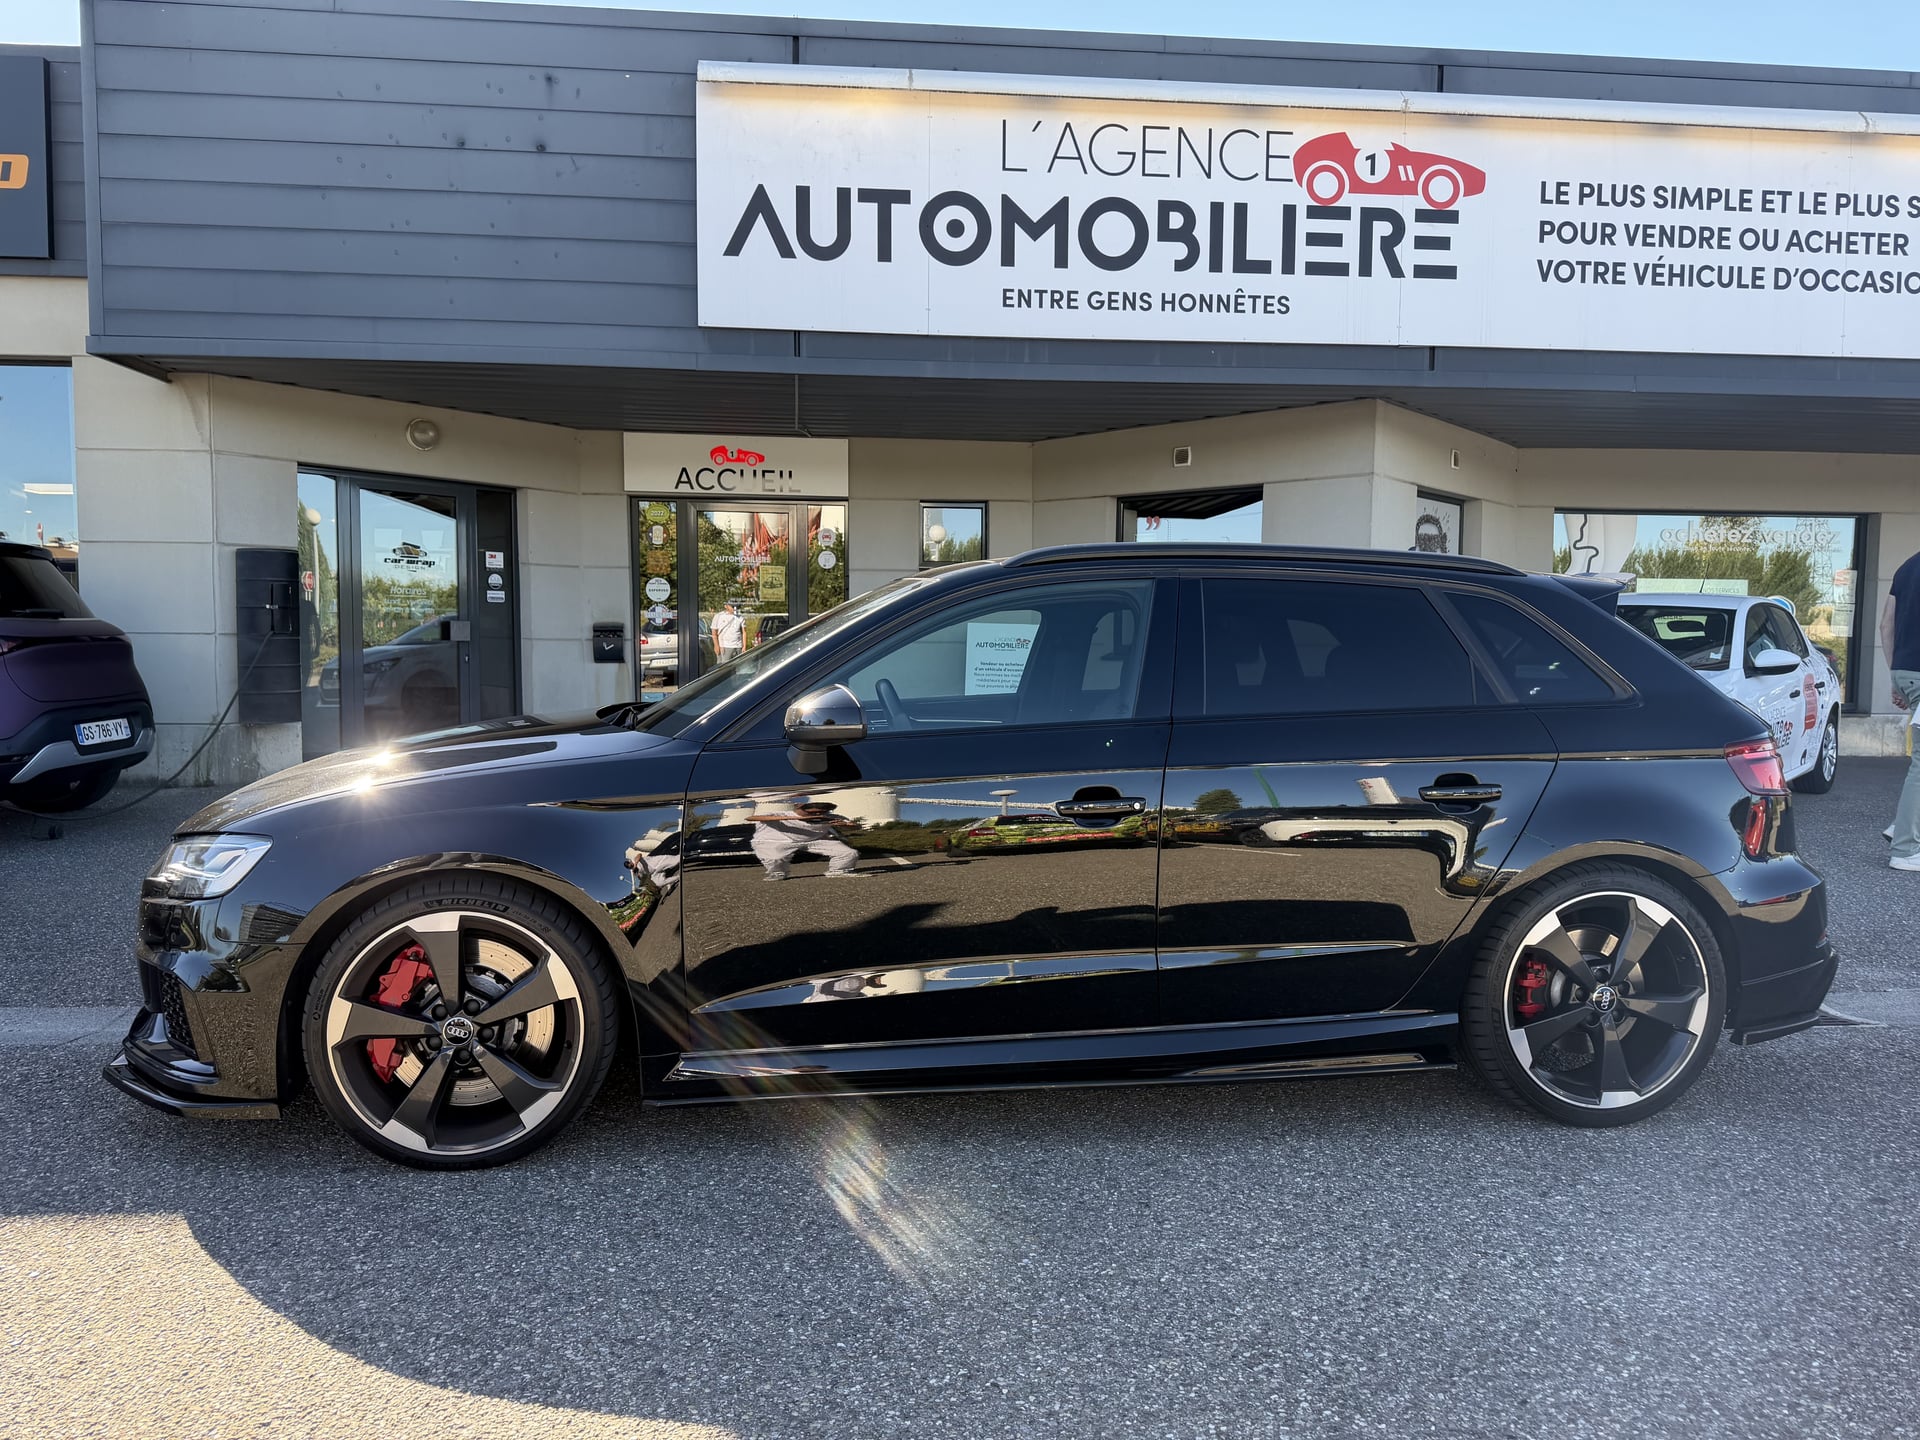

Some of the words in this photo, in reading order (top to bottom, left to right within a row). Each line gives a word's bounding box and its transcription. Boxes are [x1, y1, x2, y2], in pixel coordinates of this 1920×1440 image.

[1002, 119, 1293, 182] L'AGENCE
[1540, 181, 1570, 205] LE
[1578, 182, 1645, 208] PLUS
[1653, 185, 1753, 212] SIMPLE
[1761, 190, 1792, 213] ET
[1799, 191, 1827, 215] LE
[1835, 193, 1900, 218] PLUS
[723, 184, 1459, 280] AUTOMOBILIERE
[1539, 220, 1617, 246] POUR
[1624, 223, 1731, 250] VENDRE
[1739, 228, 1779, 252] OU
[1785, 229, 1909, 256] ACHETER
[1537, 259, 1626, 285] VOTRE
[1633, 255, 1765, 290] VÉHICULE
[1002, 288, 1079, 310] ENTRE
[1087, 291, 1152, 312] GENS
[1160, 288, 1290, 315] HONNÊTES
[441, 899, 506, 911] MICHELIN
